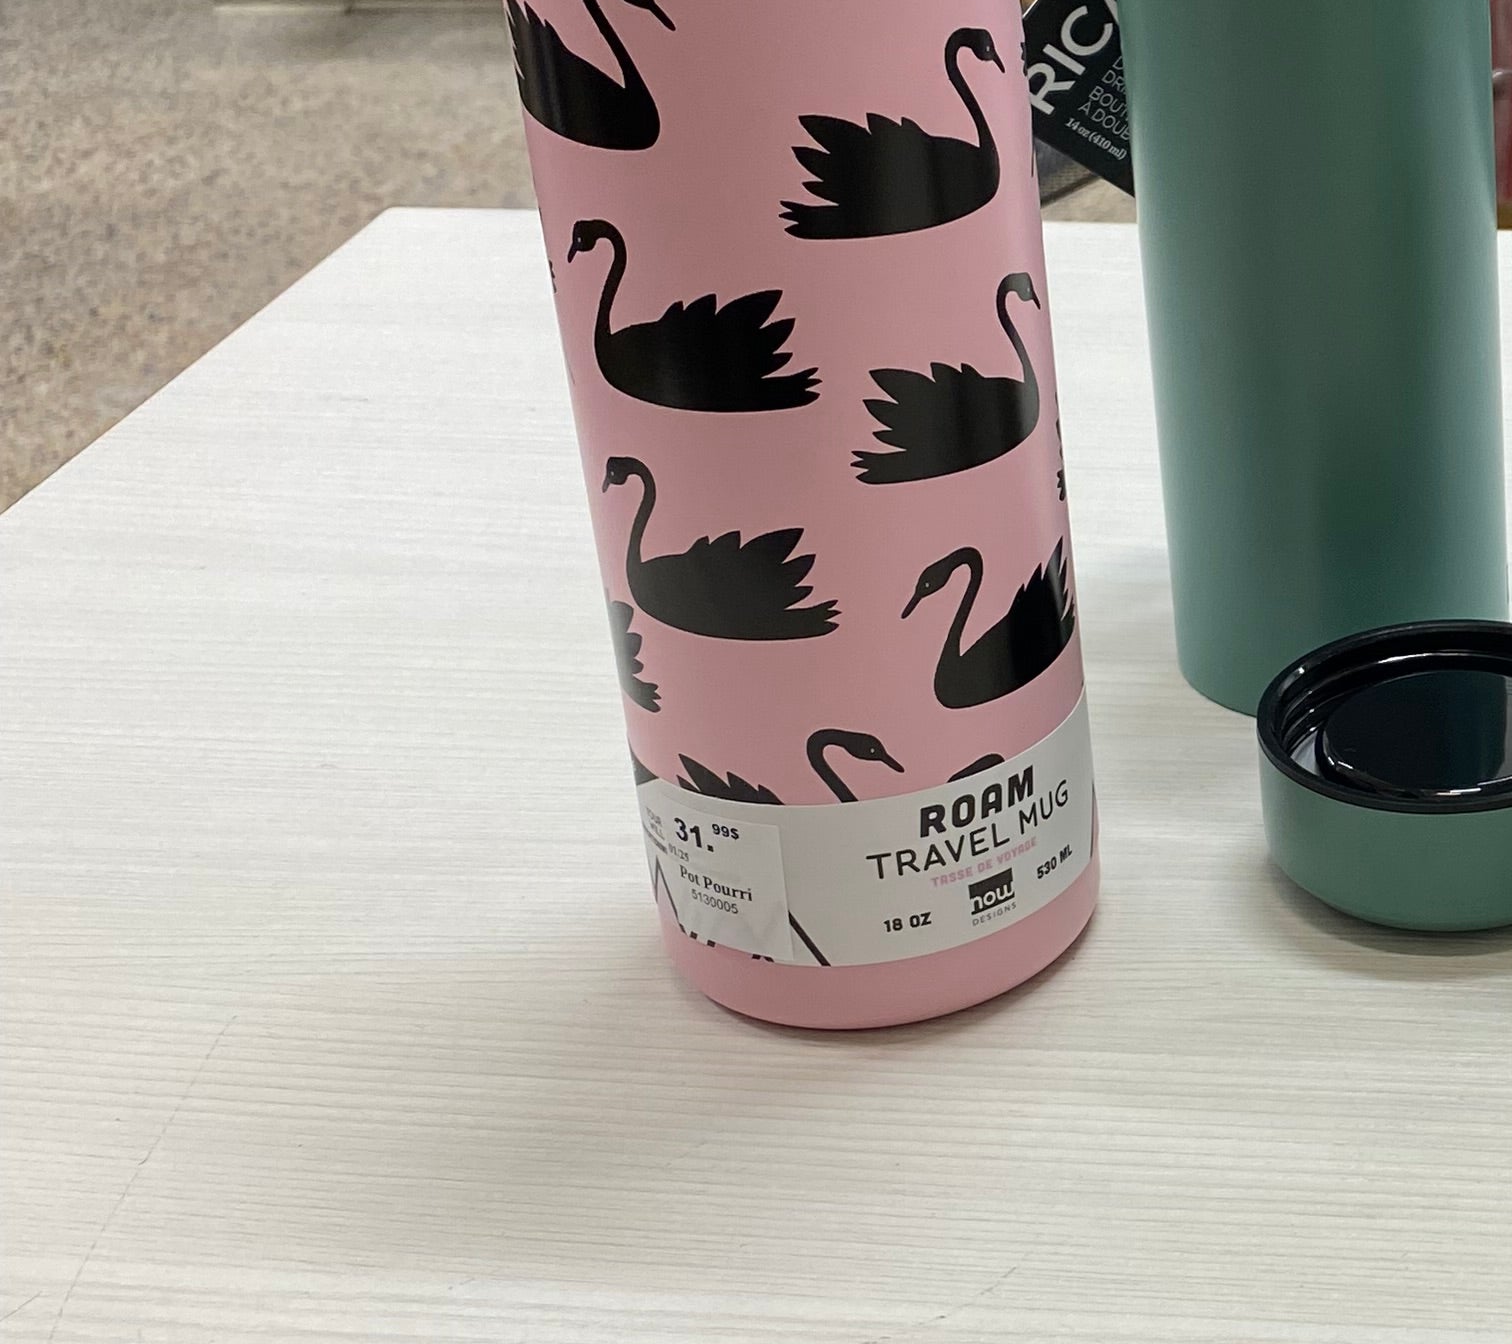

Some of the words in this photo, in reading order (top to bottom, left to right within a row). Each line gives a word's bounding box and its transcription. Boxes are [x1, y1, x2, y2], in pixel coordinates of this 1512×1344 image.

[1065, 117, 1081, 131] 14
[920, 764, 1034, 838] ROAM
[674, 817, 714, 853] 31.
[711, 823, 740, 841] 99$
[866, 822, 1011, 880] TRAVEL
[1018, 779, 1069, 835] MUG
[930, 866, 975, 888] TASSE
[977, 860, 994, 873] DE
[997, 836, 1038, 865] VOYAGE
[1036, 854, 1057, 880] 530
[1059, 844, 1073, 865] ML
[679, 864, 701, 887] Pot
[702, 874, 753, 902] Pourri
[691, 888, 740, 915] 5130005
[971, 902, 1017, 927] DESIGNS
[883, 917, 904, 933] 18
[909, 912, 933, 929] OZ
